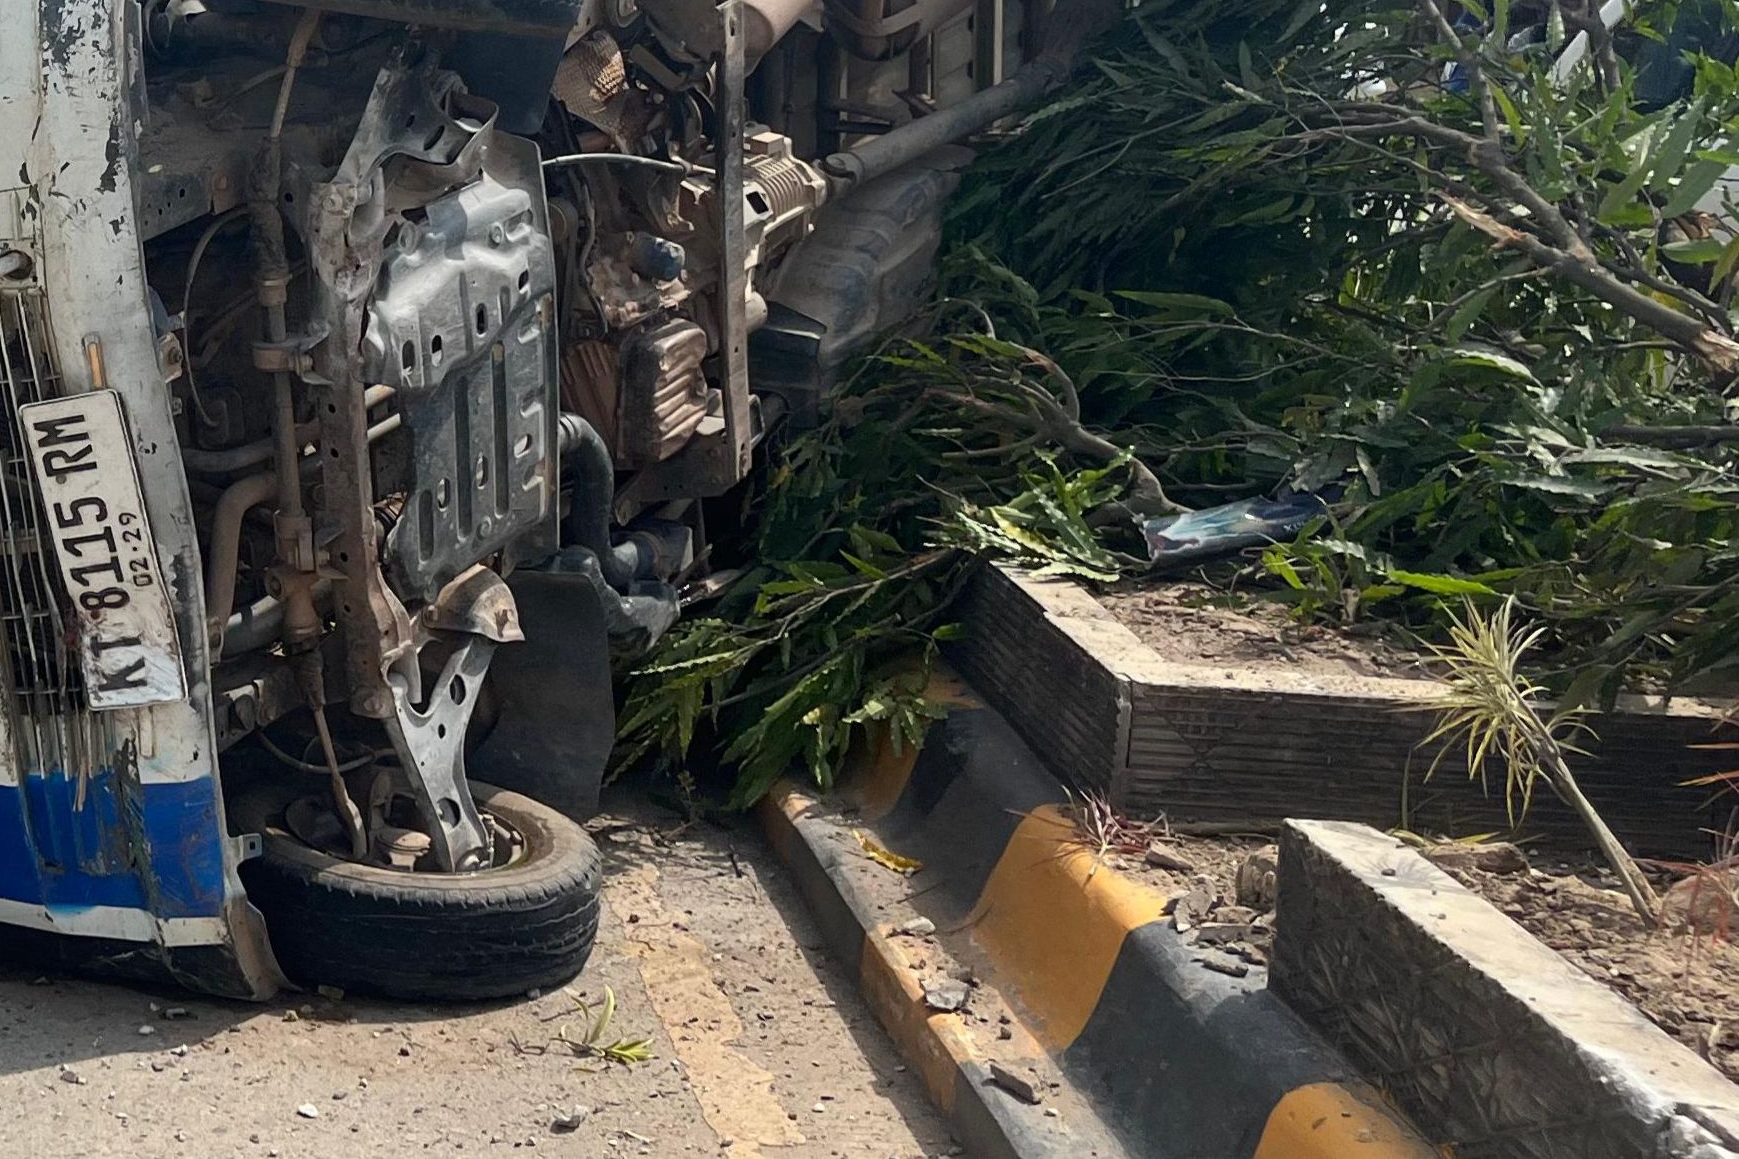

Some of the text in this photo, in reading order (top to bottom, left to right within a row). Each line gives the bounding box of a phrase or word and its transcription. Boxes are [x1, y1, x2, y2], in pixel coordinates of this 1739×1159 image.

[33, 414, 148, 691] KT 8115 RM
